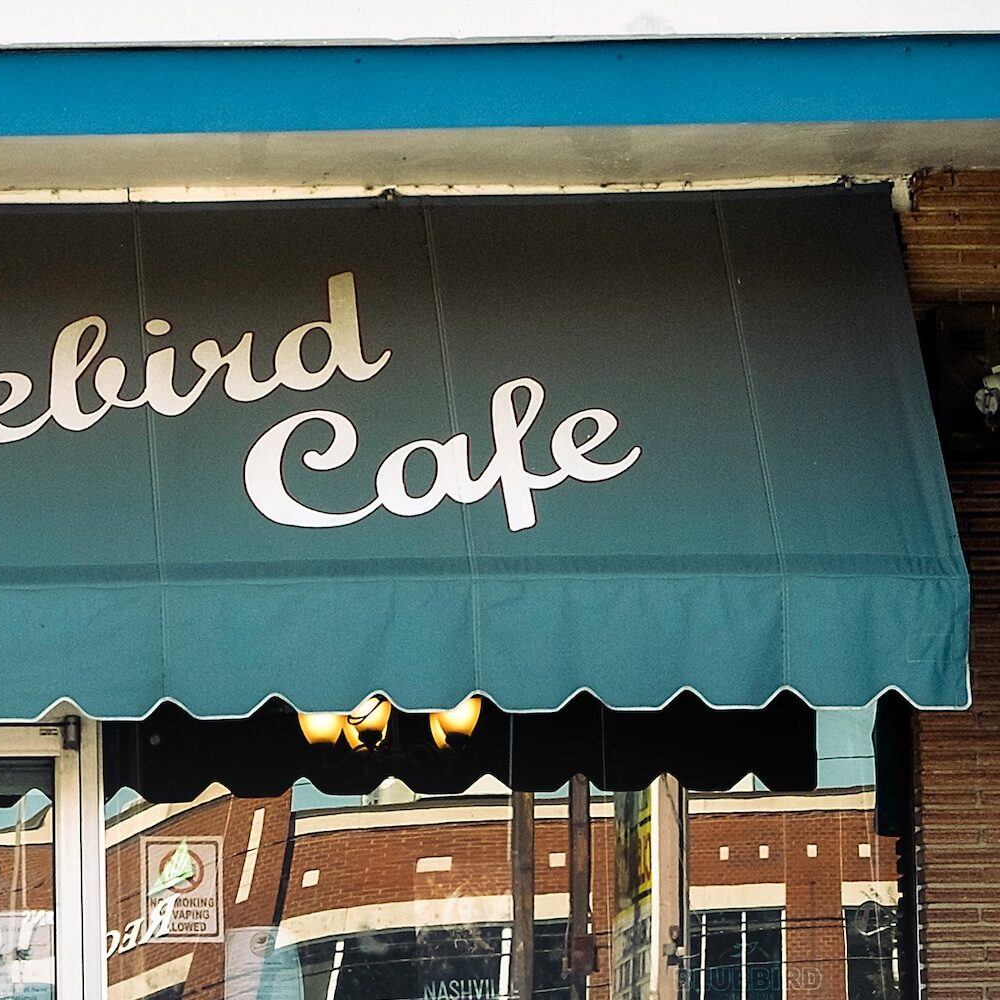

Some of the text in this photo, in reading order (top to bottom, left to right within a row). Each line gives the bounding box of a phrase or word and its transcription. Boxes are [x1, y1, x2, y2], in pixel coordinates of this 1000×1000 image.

[243, 376, 642, 532] Cafe
[173, 898, 214, 908] MOKING
[172, 910, 210, 920] VAPING
